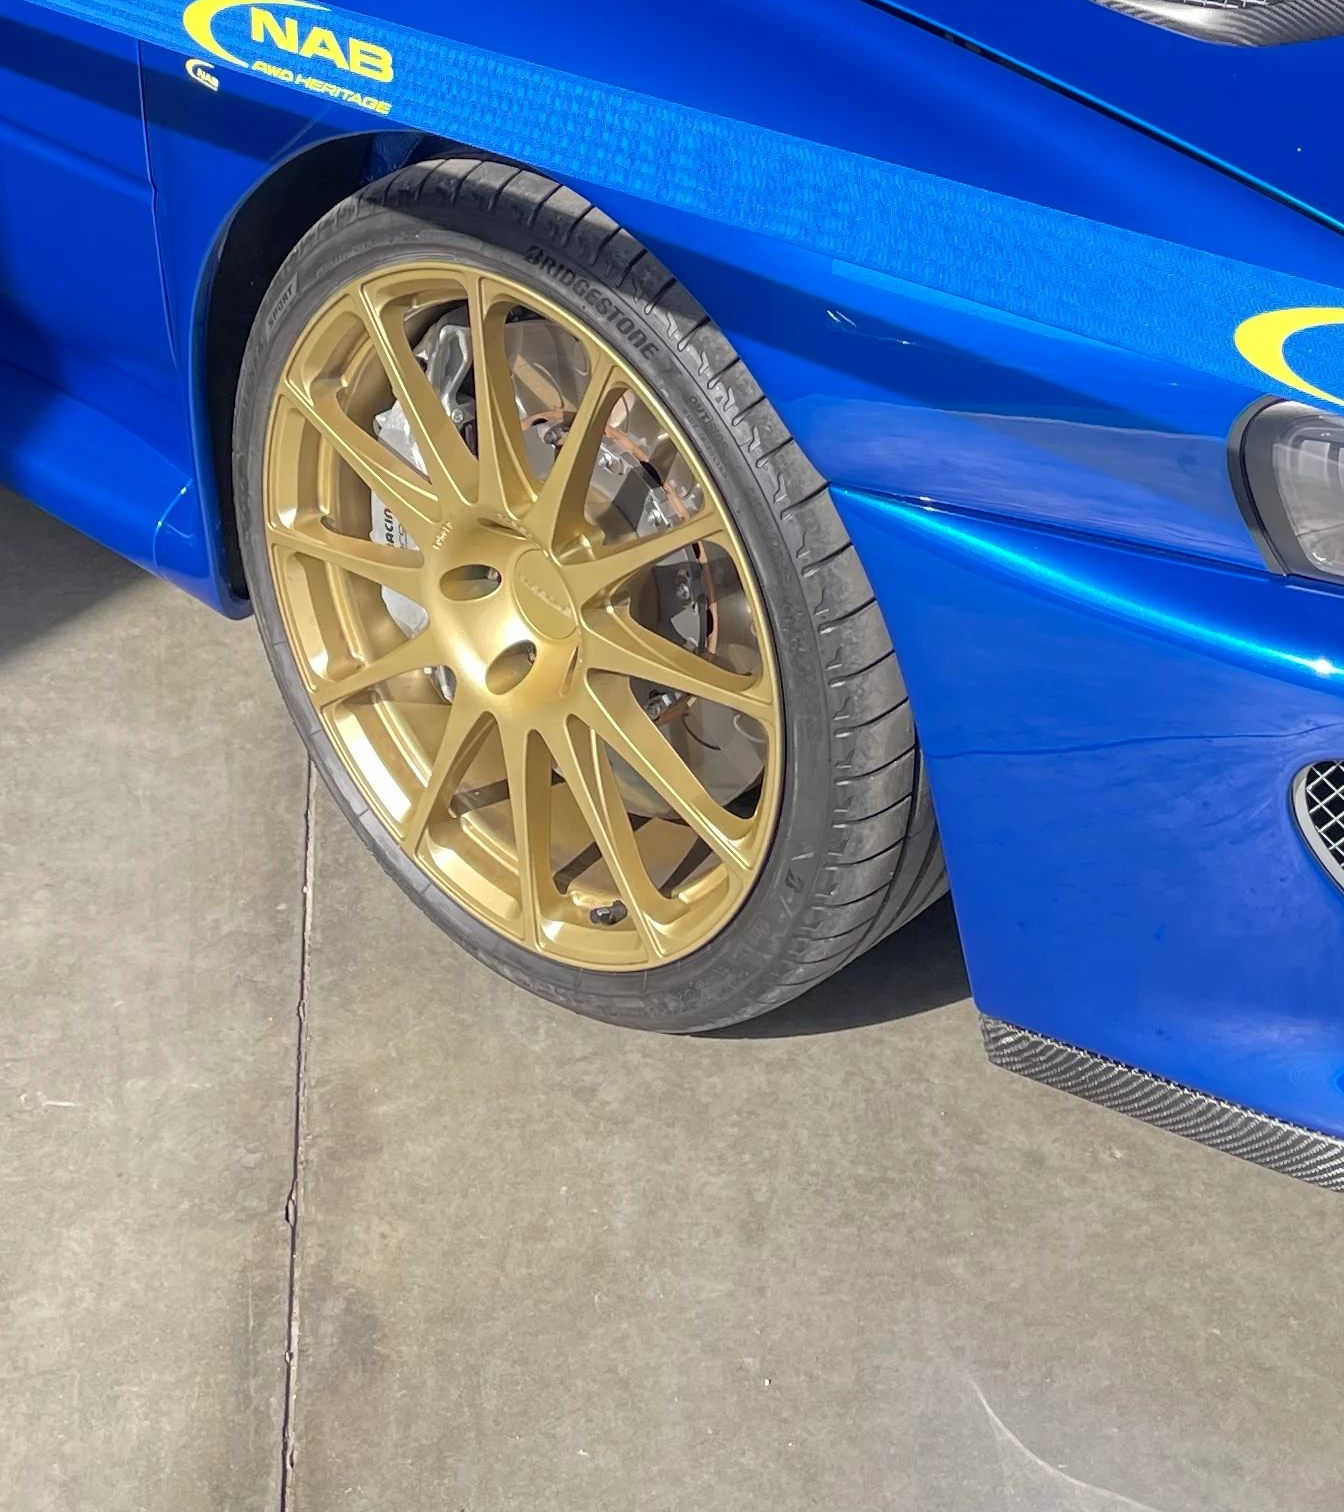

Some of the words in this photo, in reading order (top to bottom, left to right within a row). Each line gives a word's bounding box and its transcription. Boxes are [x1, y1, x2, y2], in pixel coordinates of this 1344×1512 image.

[250, 6, 395, 84] NAB
[251, 60, 296, 84] AWD
[294, 73, 393, 116] HERITAGE
[267, 284, 294, 328] SPORT
[524, 245, 659, 361] BRIDGESTONE
